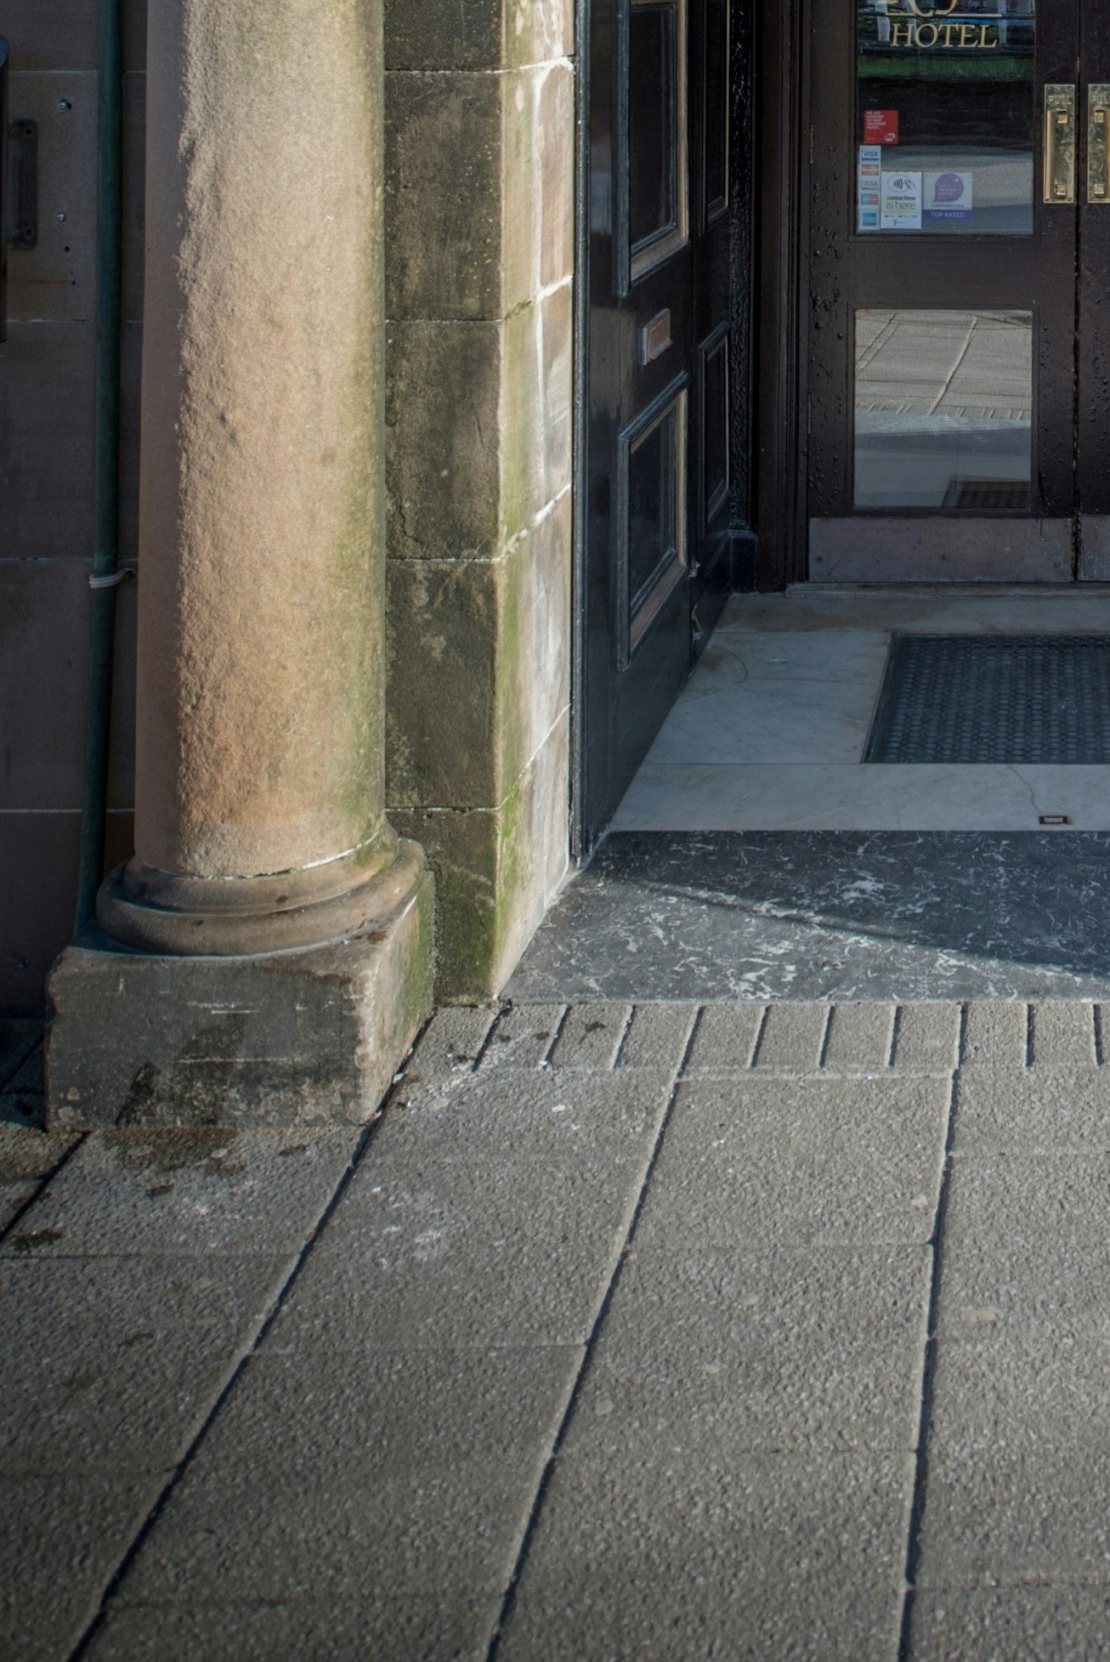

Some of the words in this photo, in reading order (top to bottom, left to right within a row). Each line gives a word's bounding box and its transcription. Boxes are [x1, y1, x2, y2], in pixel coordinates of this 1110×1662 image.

[890, 23, 998, 48] HOTEL
[863, 150, 879, 158] VISA
[886, 201, 895, 211] is
[895, 200, 917, 211] here
[930, 211, 943, 219] TOP
[944, 211, 966, 219] RATED
